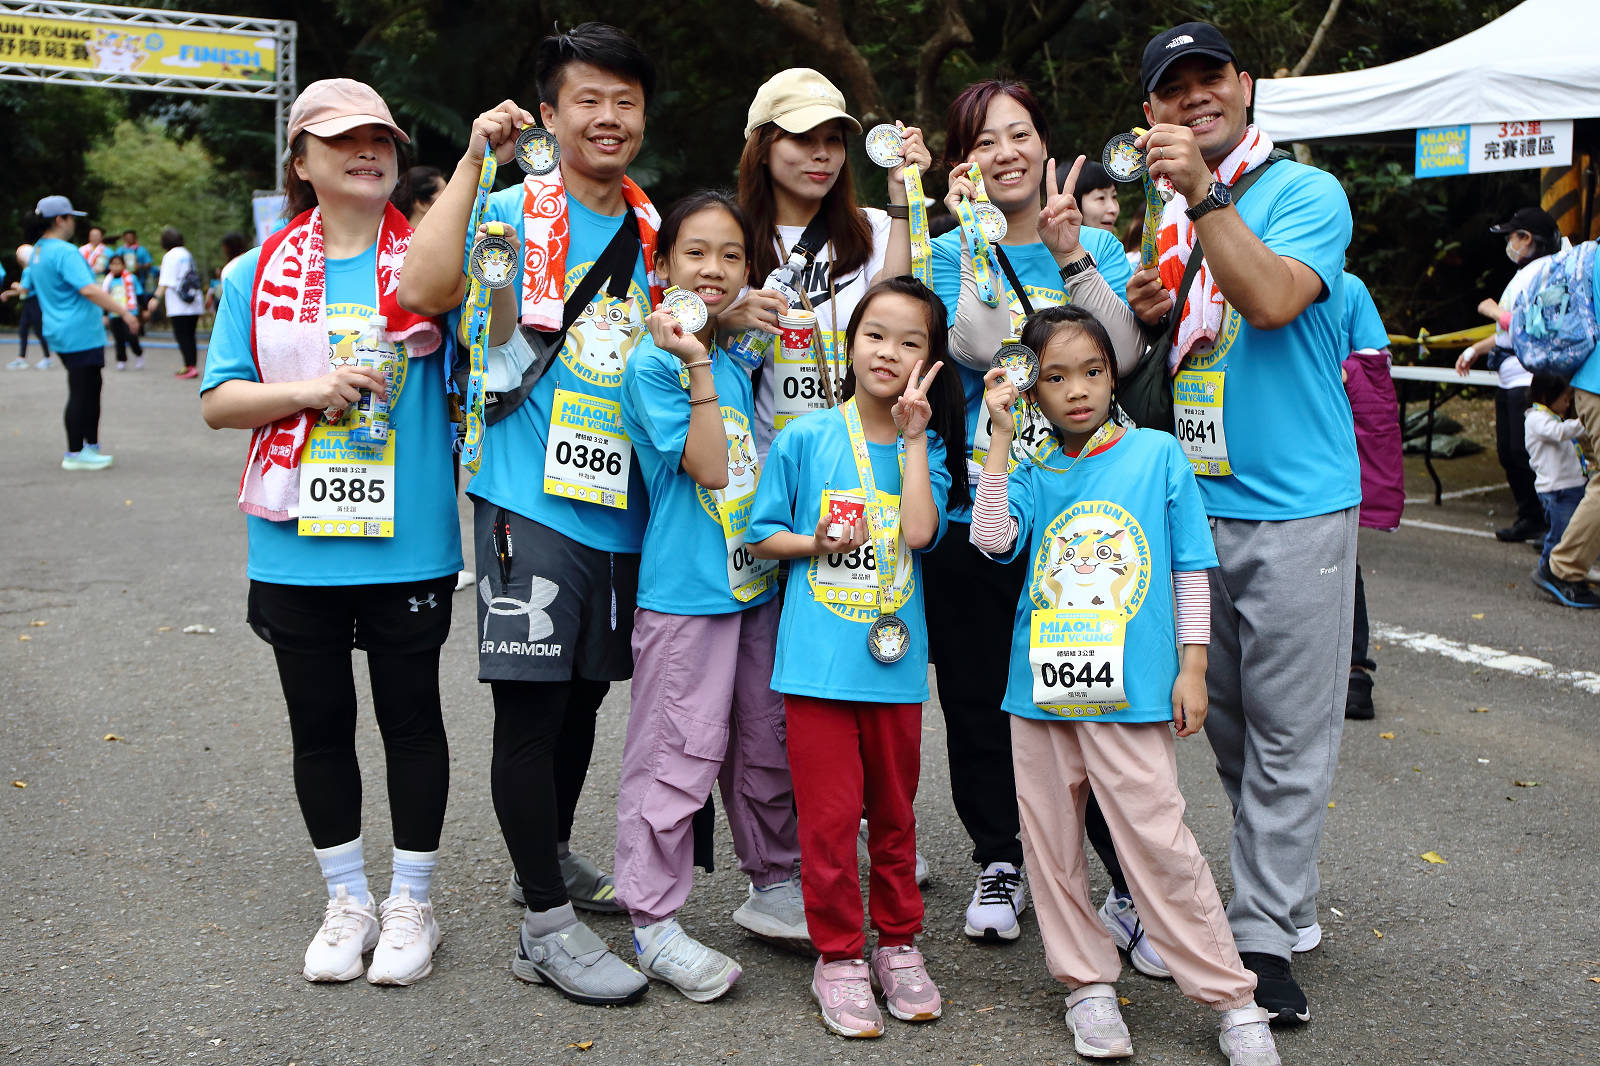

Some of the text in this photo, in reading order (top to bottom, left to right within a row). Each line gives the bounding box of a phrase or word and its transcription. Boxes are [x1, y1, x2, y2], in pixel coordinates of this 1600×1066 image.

[30, 24, 91, 40] YOUNG
[178, 44, 262, 67] FINISH
[1420, 129, 1466, 145] MIAOLI
[1497, 120, 1543, 138] 3公里
[1484, 136, 1556, 160] 完賽禮區
[1420, 153, 1465, 169] YOUNG
[1038, 290, 1063, 301] FUN
[1176, 380, 1206, 394] MIAOLI
[1189, 393, 1215, 403] YOUNG
[561, 402, 616, 424] MIAOLI
[560, 413, 625, 435] FUN YOUNG
[1178, 417, 1216, 445] 0641
[310, 450, 384, 461] FUN YOUNG
[555, 440, 622, 476] 0386
[310, 477, 385, 503] 0385
[1050, 504, 1094, 536] MIAOLI
[1096, 503, 1123, 521] FUN
[1124, 516, 1148, 566] YOUNG
[828, 545, 877, 571] 038
[1320, 565, 1338, 575] Fresh
[1130, 570, 1148, 607] 2025
[1040, 621, 1101, 634] MIAOLI
[1040, 632, 1113, 643] FUN YOUNG
[496, 640, 562, 657] ARMOUR
[1041, 661, 1114, 689] 0644
